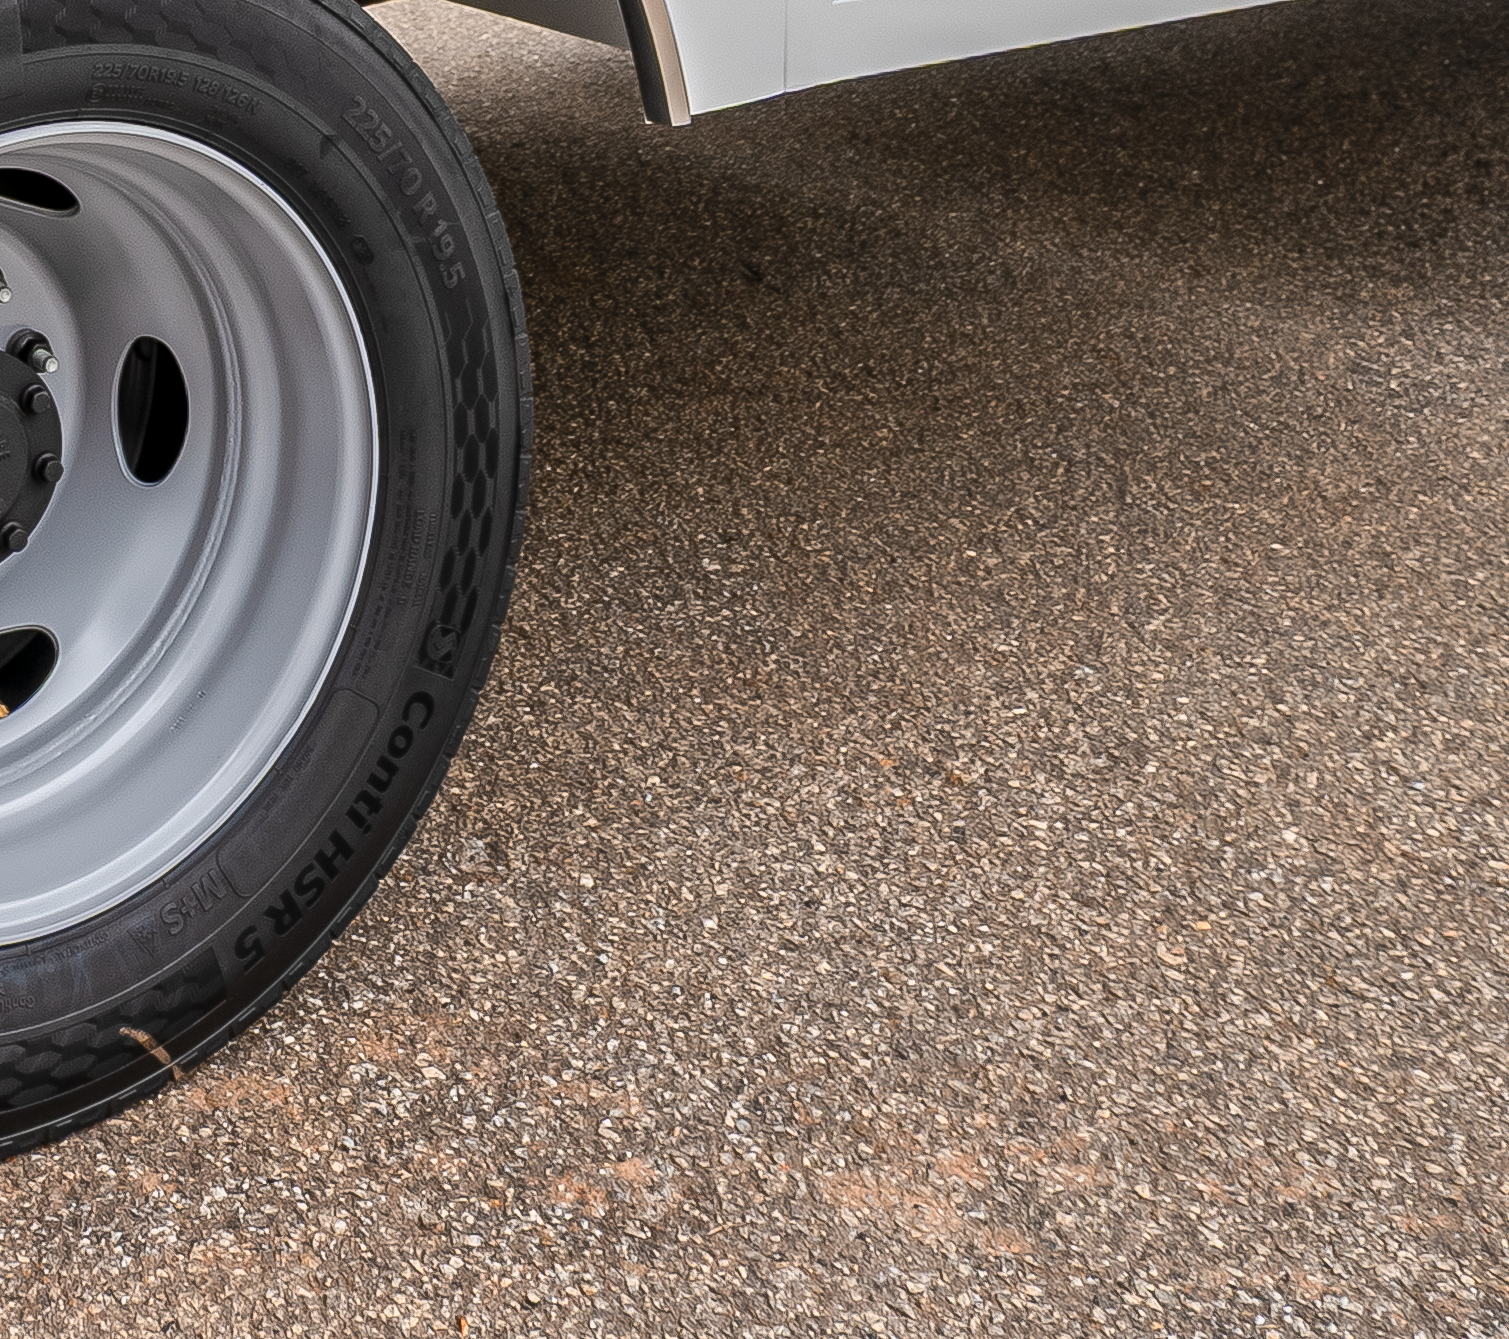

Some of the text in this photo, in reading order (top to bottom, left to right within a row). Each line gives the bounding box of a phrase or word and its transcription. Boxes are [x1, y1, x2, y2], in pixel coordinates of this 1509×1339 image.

[345, 690, 435, 835] Conti
[158, 862, 237, 938] M+S
[262, 828, 355, 937] HSR
[233, 924, 266, 974] 5
